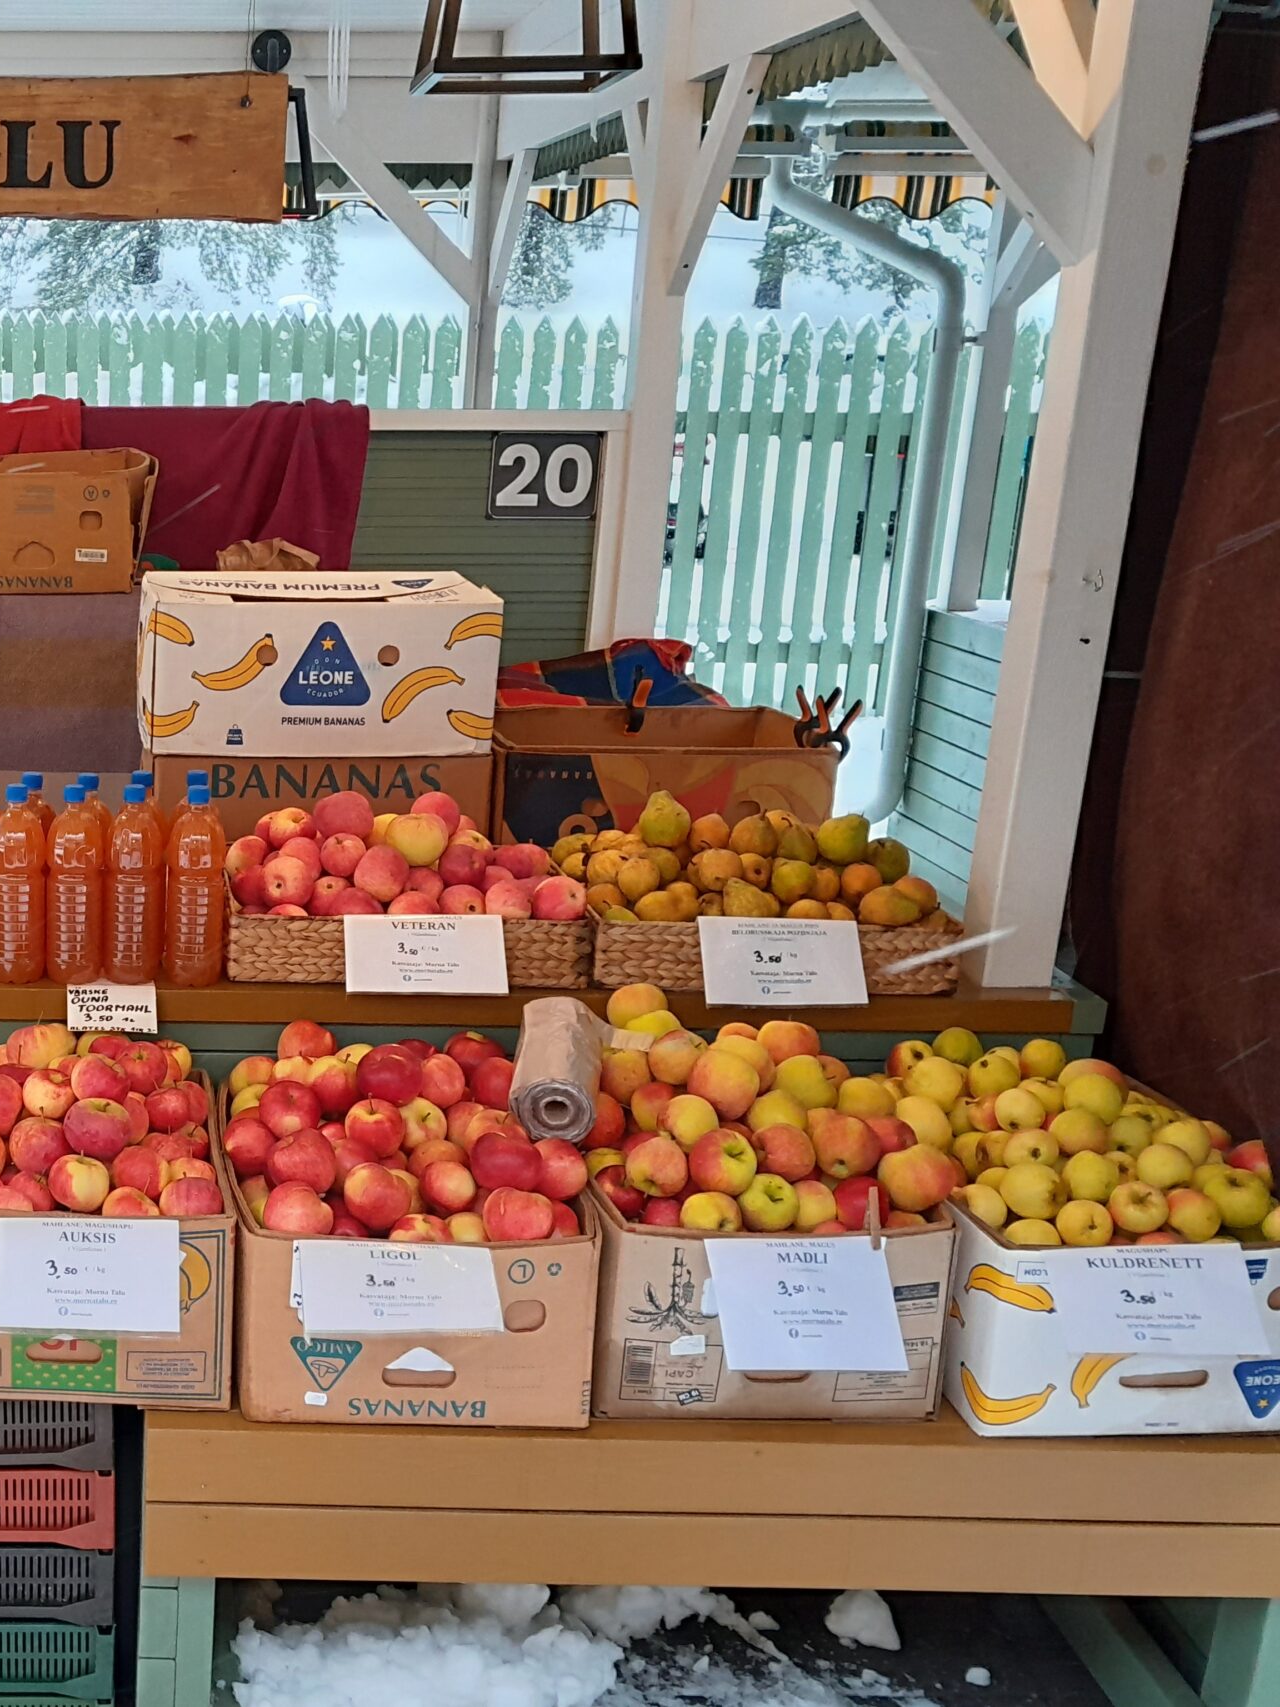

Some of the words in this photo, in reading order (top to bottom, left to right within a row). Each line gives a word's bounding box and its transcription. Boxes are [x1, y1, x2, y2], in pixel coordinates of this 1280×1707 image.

[495, 443, 593, 508] 20
[179, 578, 278, 590] BANANAS
[283, 582, 380, 592] PREMIUM
[314, 657, 341, 665] DON
[298, 670, 354, 685] LEONE
[306, 688, 344, 698] ECUADOR
[281, 716, 322, 726] PREMIUM
[323, 716, 366, 726] BANANAS
[209, 763, 442, 799] BANANAS
[391, 921, 456, 930] VETERAN
[78, 1004, 152, 1013] TOORMAHL
[58, 1231, 117, 1244] AUKSIS
[369, 1250, 422, 1261] LIGOL
[777, 1252, 829, 1264] MADLI
[1086, 1257, 1204, 1269] KULDRENETT
[665, 1369, 694, 1379] CAPI
[1245, 1374, 1280, 1388] EONE
[348, 1398, 486, 1418] BANANAS
